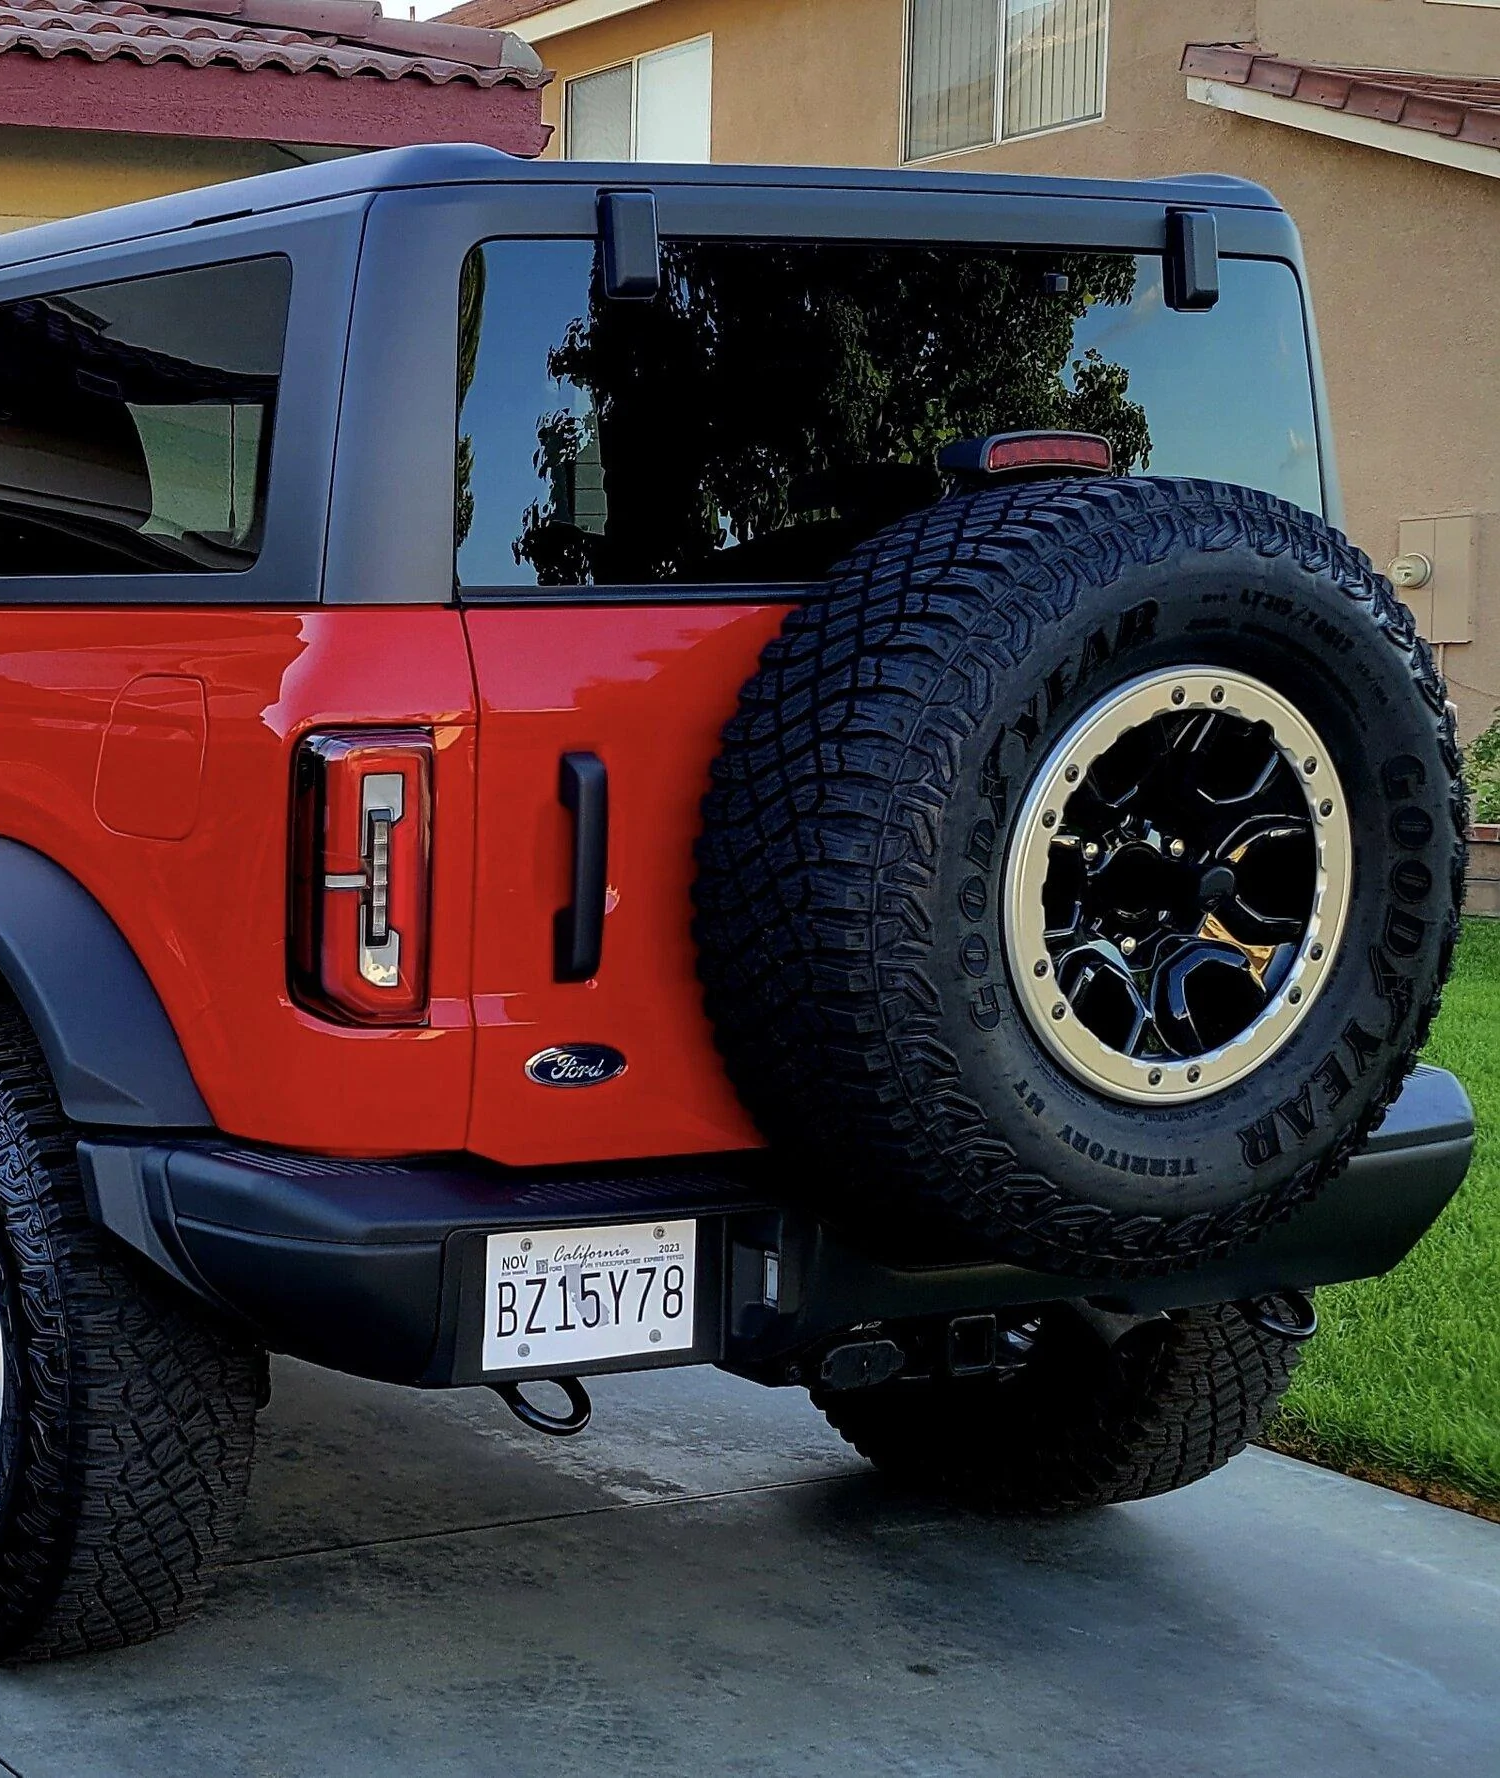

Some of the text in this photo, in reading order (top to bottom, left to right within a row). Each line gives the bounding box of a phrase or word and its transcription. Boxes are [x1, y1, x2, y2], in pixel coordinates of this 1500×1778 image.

[1235, 754, 1433, 1169] GOODYEAR
[543, 1052, 605, 1080] Ford
[1056, 1123, 1198, 1179] TERRITORY
[501, 1254, 529, 1272] NOV
[553, 1243, 631, 1269] California
[658, 1242, 681, 1254] 2023
[496, 1264, 685, 1338] BZ15Y78
